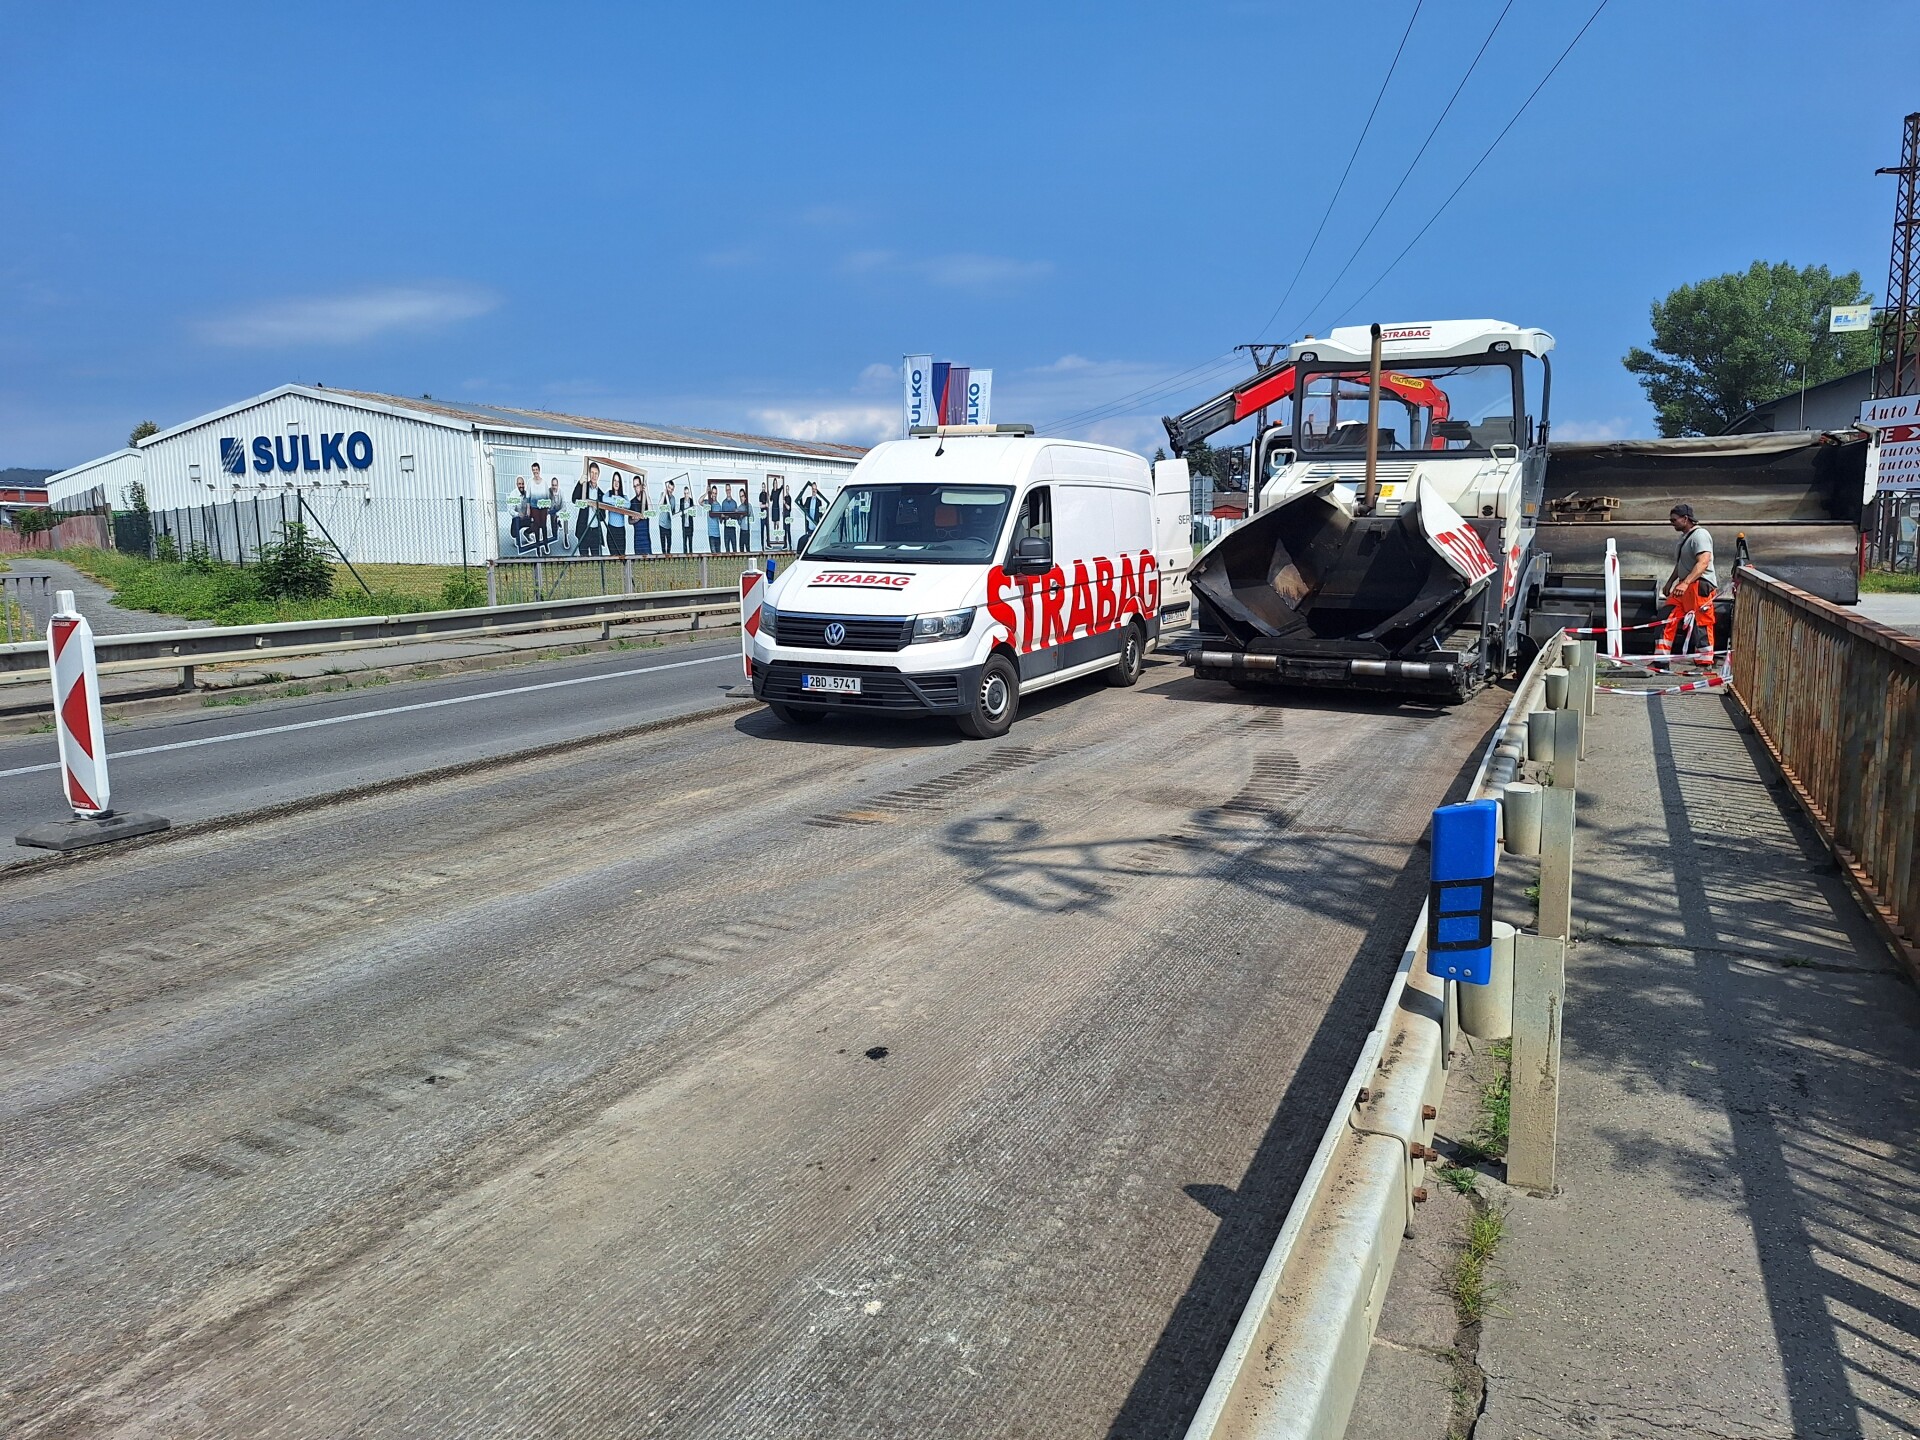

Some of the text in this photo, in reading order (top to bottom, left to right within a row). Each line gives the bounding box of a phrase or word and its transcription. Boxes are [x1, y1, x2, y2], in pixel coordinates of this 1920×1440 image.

[1382, 330, 1431, 339] STRABAG
[968, 382, 980, 426] ULKO
[1865, 404, 1908, 421] Auto
[252, 431, 373, 473] SULKO
[811, 574, 911, 586] STRABAG
[987, 549, 1157, 653] STRABAG
[810, 676, 856, 690] 2BD 5741
